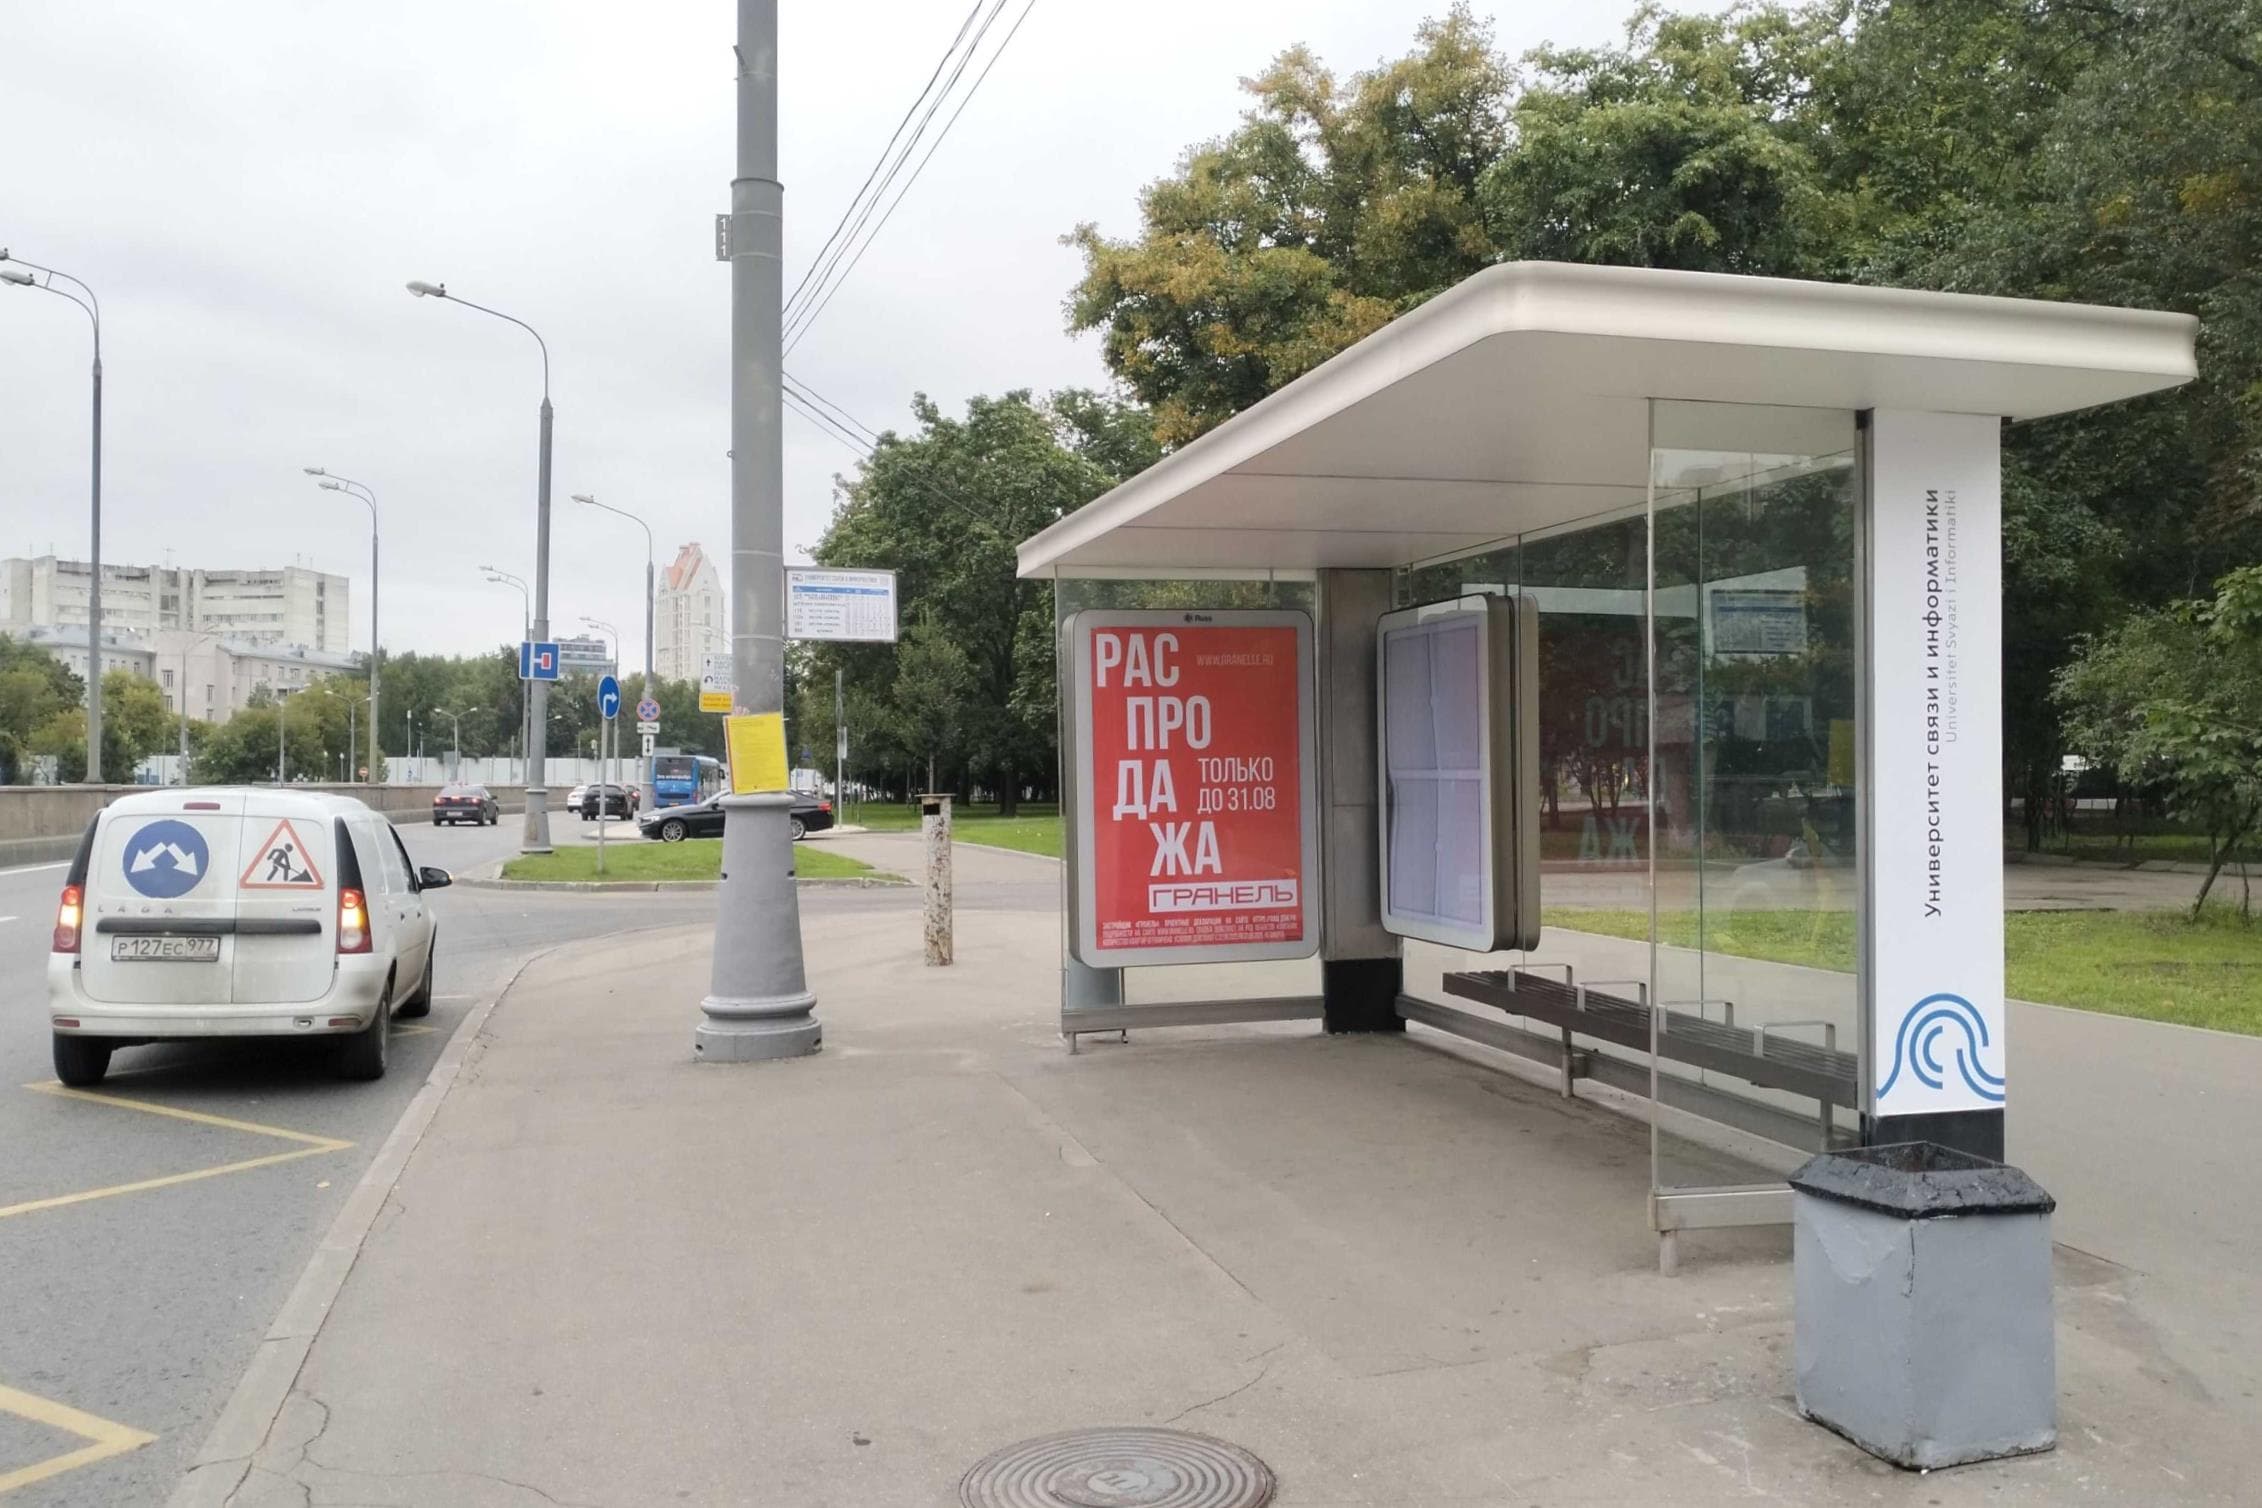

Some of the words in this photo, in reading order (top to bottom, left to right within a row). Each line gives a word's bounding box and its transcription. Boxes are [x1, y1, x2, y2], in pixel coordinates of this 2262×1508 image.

[1944, 490, 1958, 583] Informatiki
[1922, 490, 1943, 658] информатики
[1945, 599, 1959, 649] Svyazi
[1095, 633, 1180, 687] РАС
[1927, 666, 1940, 679] и
[1126, 695, 1212, 750] ПРО
[1927, 688, 1940, 755] связи
[1944, 653, 1958, 743] Universitet
[1112, 759, 1178, 821] ДА
[1197, 757, 1274, 783] ТОЛЬКО
[1197, 788, 1224, 814] ДО
[1227, 786, 1276, 811] 31.08
[1149, 821, 1223, 877] ЖА
[1924, 762, 1944, 918] Университет
[1152, 885, 1294, 908] ГРАНЕЛЬ
[187, 938, 215, 952] 977
